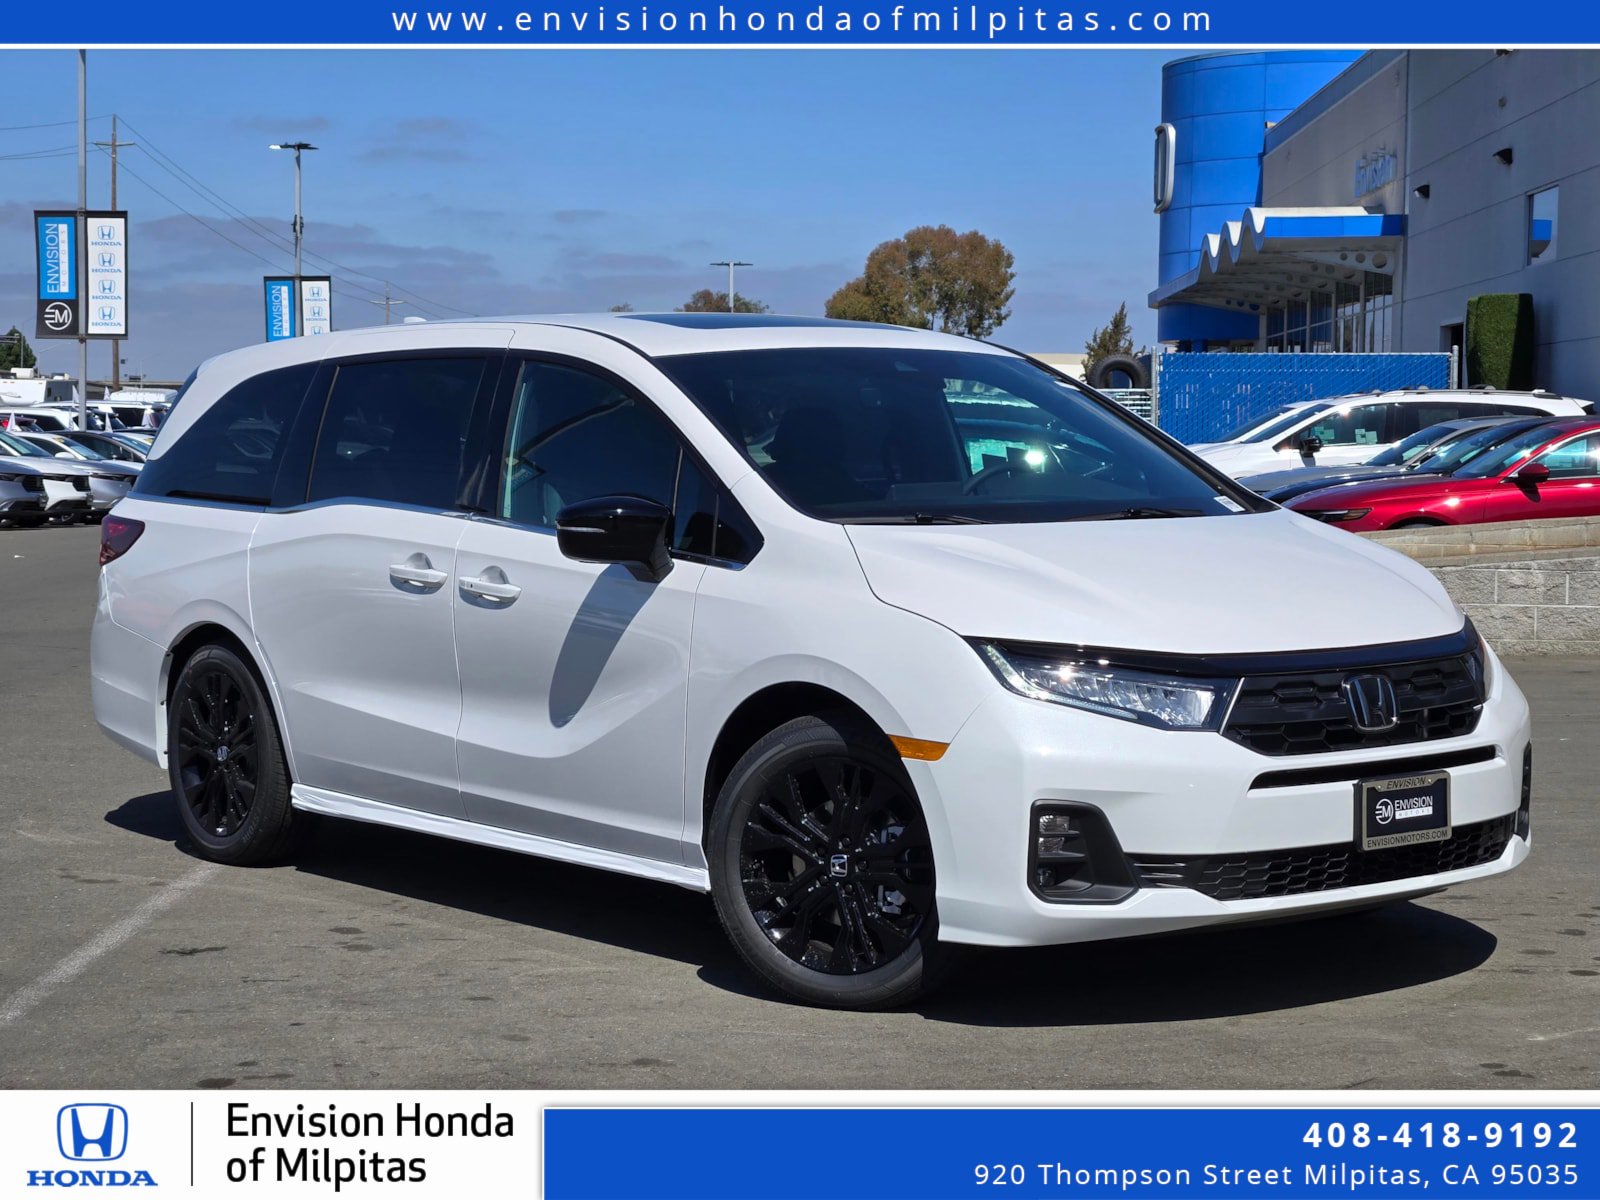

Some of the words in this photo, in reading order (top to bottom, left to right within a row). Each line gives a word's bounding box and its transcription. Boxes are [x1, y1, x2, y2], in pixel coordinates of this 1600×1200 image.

[46, 223, 60, 293] ENVISION
[272, 286, 282, 336] ENVISION
[1387, 777, 1426, 789] ENVISION
[1395, 796, 1433, 811] ENVISION
[1367, 829, 1448, 848] ENVISIONMOTORS.COM
